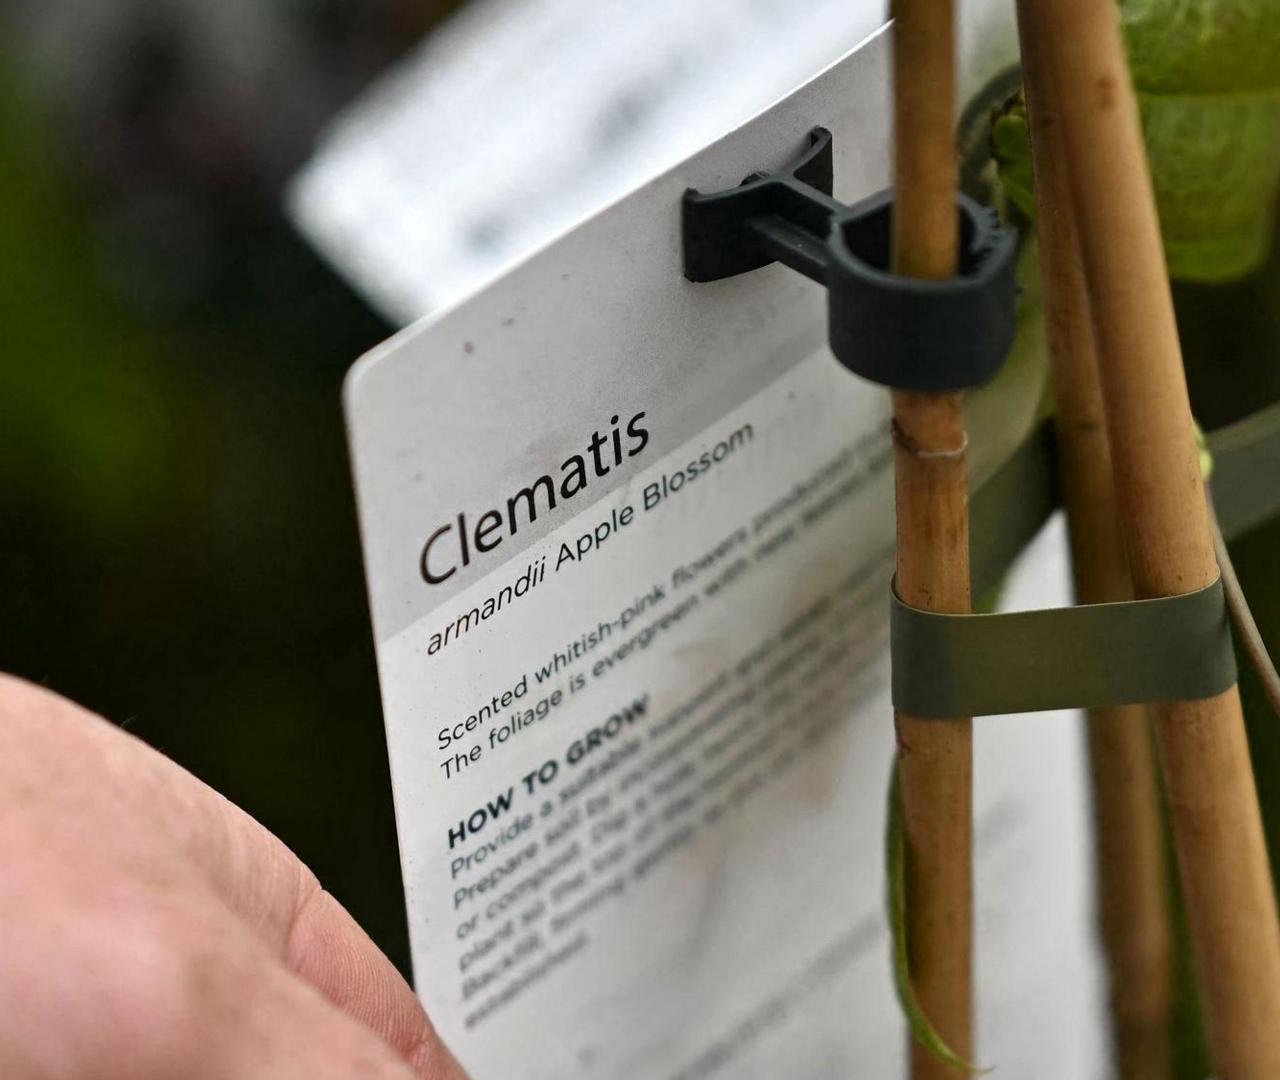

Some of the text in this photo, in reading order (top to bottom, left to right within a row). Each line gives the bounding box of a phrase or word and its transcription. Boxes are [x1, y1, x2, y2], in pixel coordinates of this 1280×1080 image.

[419, 411, 649, 586] Clematis
[427, 556, 546, 656] armandii
[556, 505, 634, 572] Apple
[642, 423, 754, 511] Blossom
[437, 675, 528, 750] Scented
[534, 584, 665, 683] whitish-pink
[440, 745, 482, 780] The
[488, 688, 562, 750] foliage
[570, 675, 586, 694] is
[592, 594, 699, 677] evergreen
[448, 786, 514, 849] HOW
[522, 759, 559, 795] TO
[566, 692, 649, 764] GROW
[450, 813, 533, 880] Provide
[454, 842, 538, 910] Prepare
[457, 913, 478, 939] or
